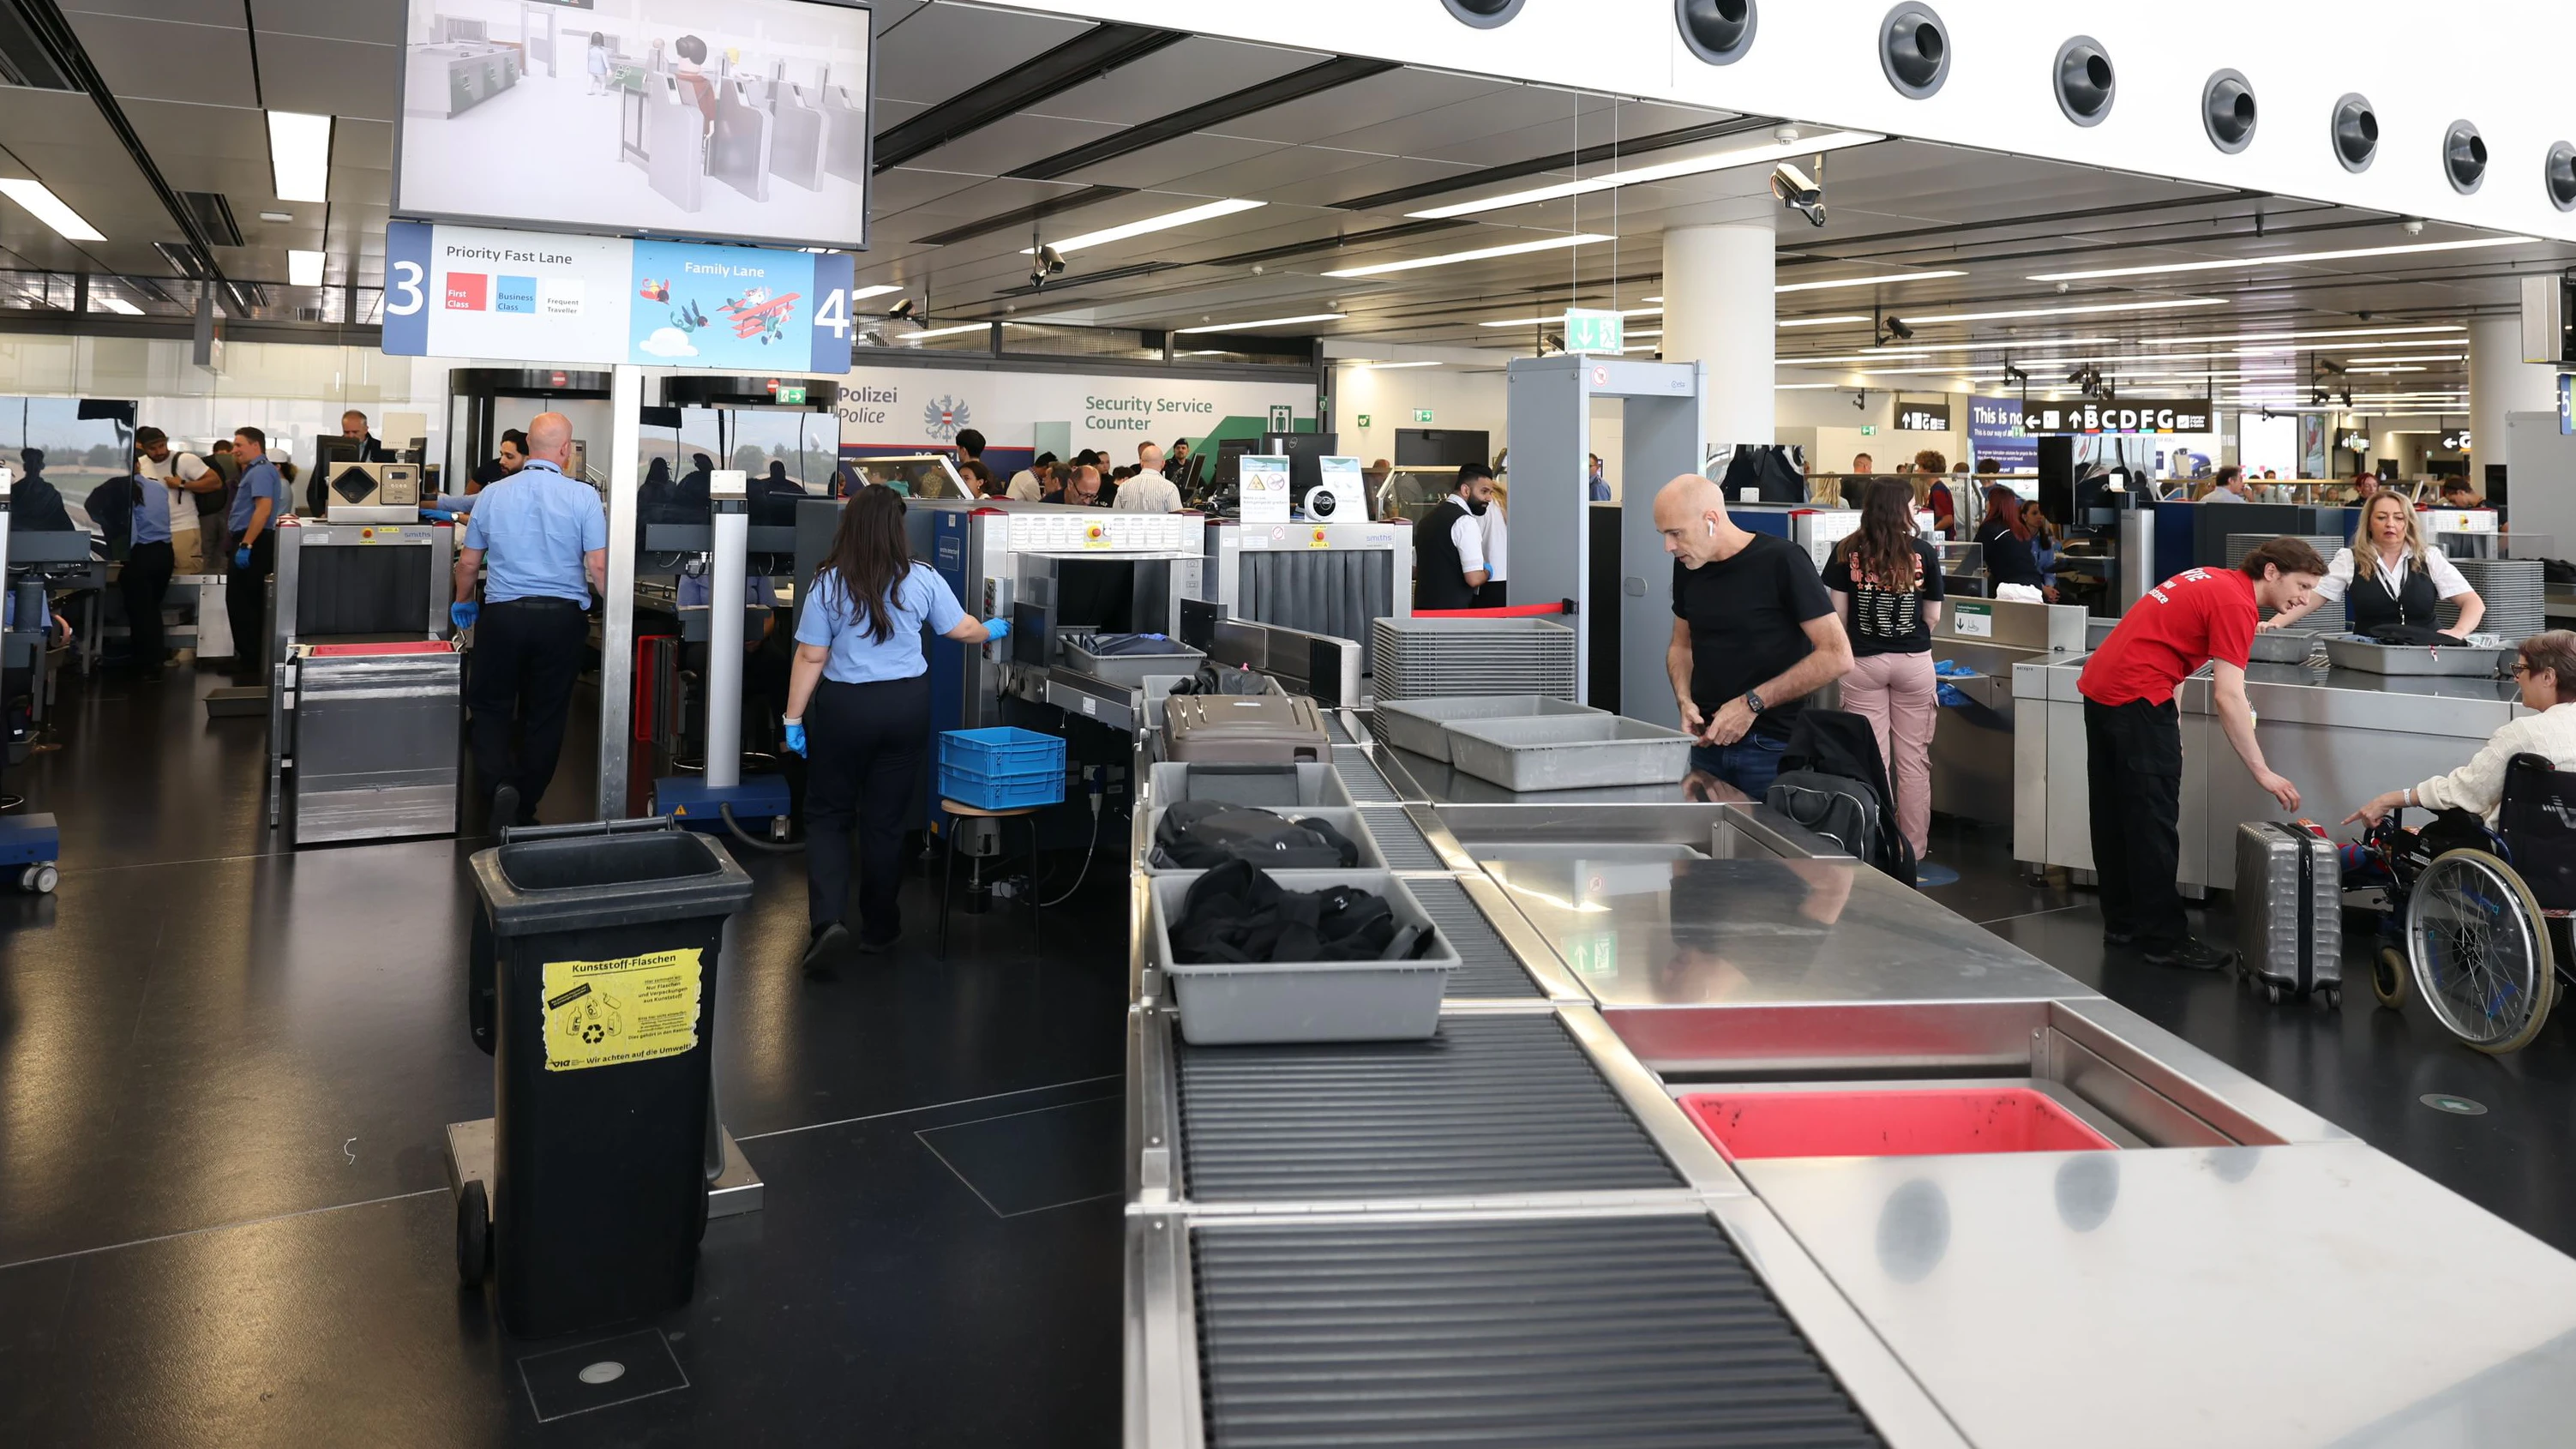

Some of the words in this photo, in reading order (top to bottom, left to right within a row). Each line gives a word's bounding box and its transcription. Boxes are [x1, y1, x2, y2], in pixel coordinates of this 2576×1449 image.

[446, 245, 501, 263] Priority
[504, 248, 537, 263] Fast
[538, 250, 573, 265] Lane
[685, 262, 730, 278] Family
[733, 265, 765, 278] Lane
[386, 261, 424, 316] 3
[447, 288, 466, 298] First
[447, 298, 469, 309] Class
[497, 292, 534, 302] Business
[547, 297, 579, 307] Frequent
[497, 302, 519, 311] Class
[547, 304, 578, 315] Traveller
[814, 288, 850, 339] 4
[838, 386, 898, 404] Polizei
[1085, 394, 1152, 416] Security
[1156, 396, 1213, 414] Service
[2561, 390, 2570, 417] 5
[839, 406, 886, 424] Police
[1085, 414, 1151, 430] Counter
[1973, 406, 1997, 425] This
[1998, 407, 2007, 425] is
[2084, 410, 2099, 429] B
[2101, 409, 2117, 429] C
[2119, 409, 2137, 429] D
[2141, 409, 2154, 429] F
[2157, 409, 2174, 429] G
[1922, 418, 1930, 430] G
[1974, 428, 1983, 436] This
[404, 531, 431, 539] smiths
[572, 954, 676, 972] Kunststoff-Flaschen
[650, 987, 688, 996] Verpackungen
[654, 993, 683, 1002] Kunststoff
[639, 1031, 656, 1039] gehört
[586, 1055, 601, 1064] Wir
[602, 1053, 630, 1061] achten
[646, 1048, 658, 1056] die
[659, 1043, 692, 1054] Umwelt!
